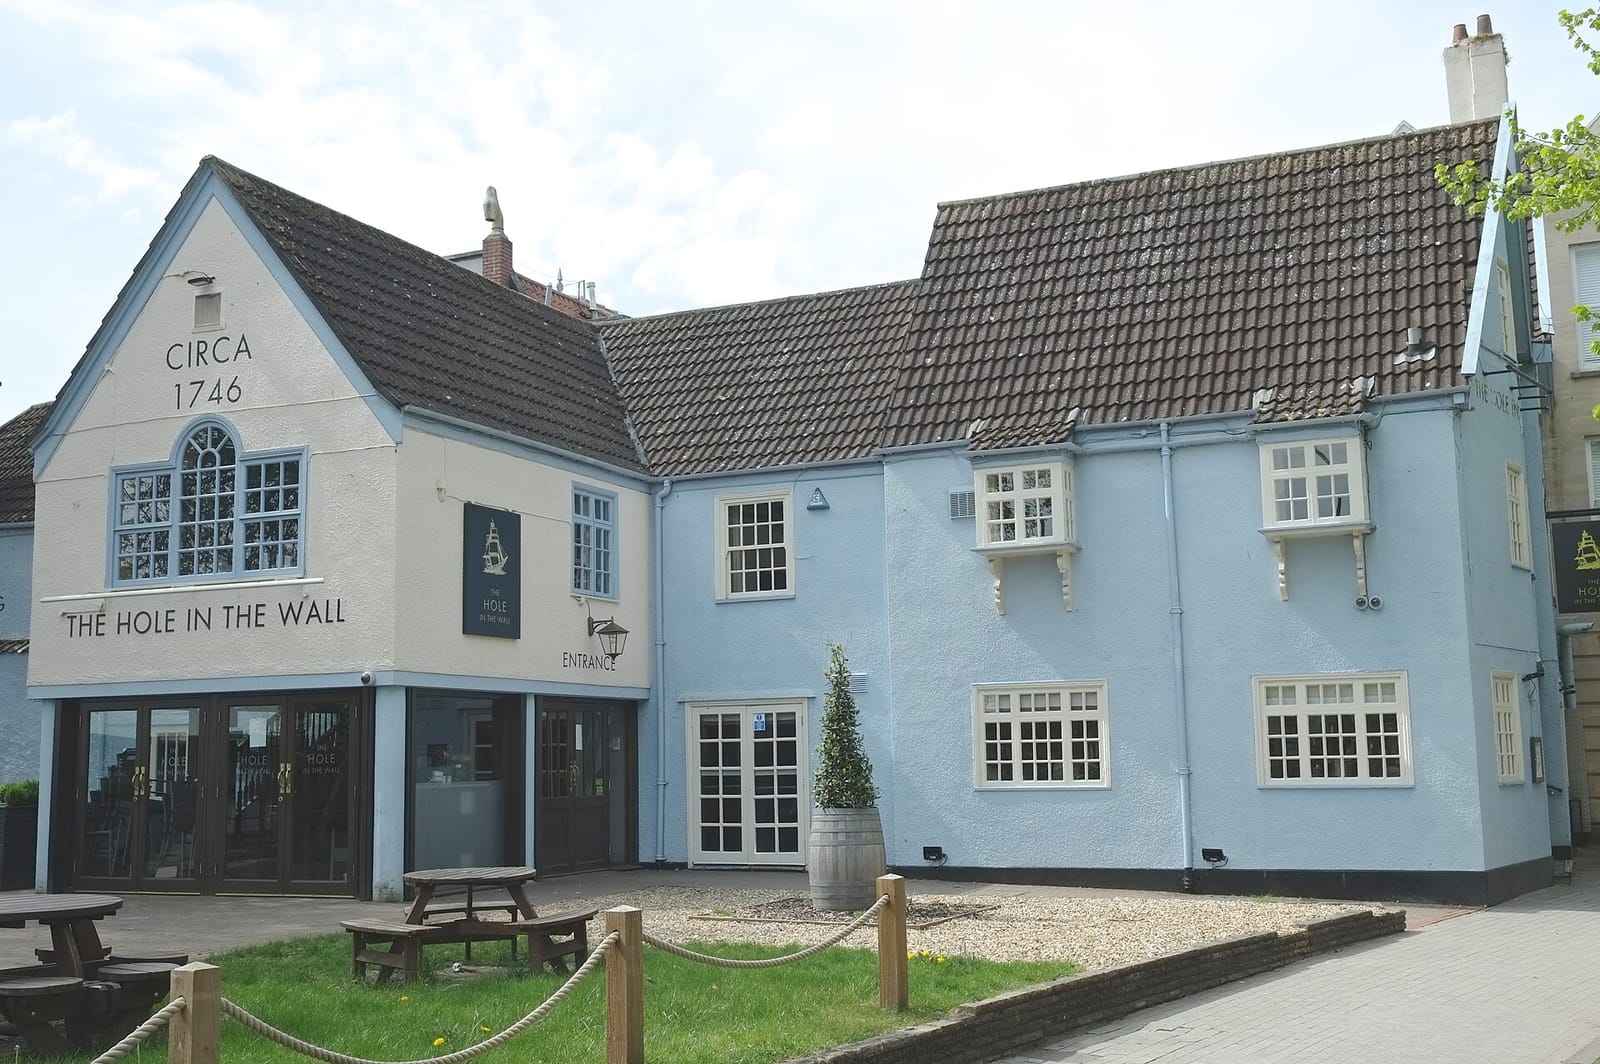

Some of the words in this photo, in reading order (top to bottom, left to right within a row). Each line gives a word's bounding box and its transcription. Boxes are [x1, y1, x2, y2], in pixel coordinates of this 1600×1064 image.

[166, 333, 252, 370] CIRCA
[175, 375, 241, 410] 1746
[490, 587, 501, 597] THE
[483, 599, 507, 613] HOLE
[67, 613, 106, 638] THE
[117, 609, 176, 635] HOLE
[187, 607, 211, 632] IN
[222, 604, 266, 630] THE
[278, 598, 345, 627] WALL
[487, 614, 497, 623] THE
[562, 651, 616, 672] ENTRANCE
[241, 754, 268, 766] HOLE
[307, 753, 336, 765] HOLE
